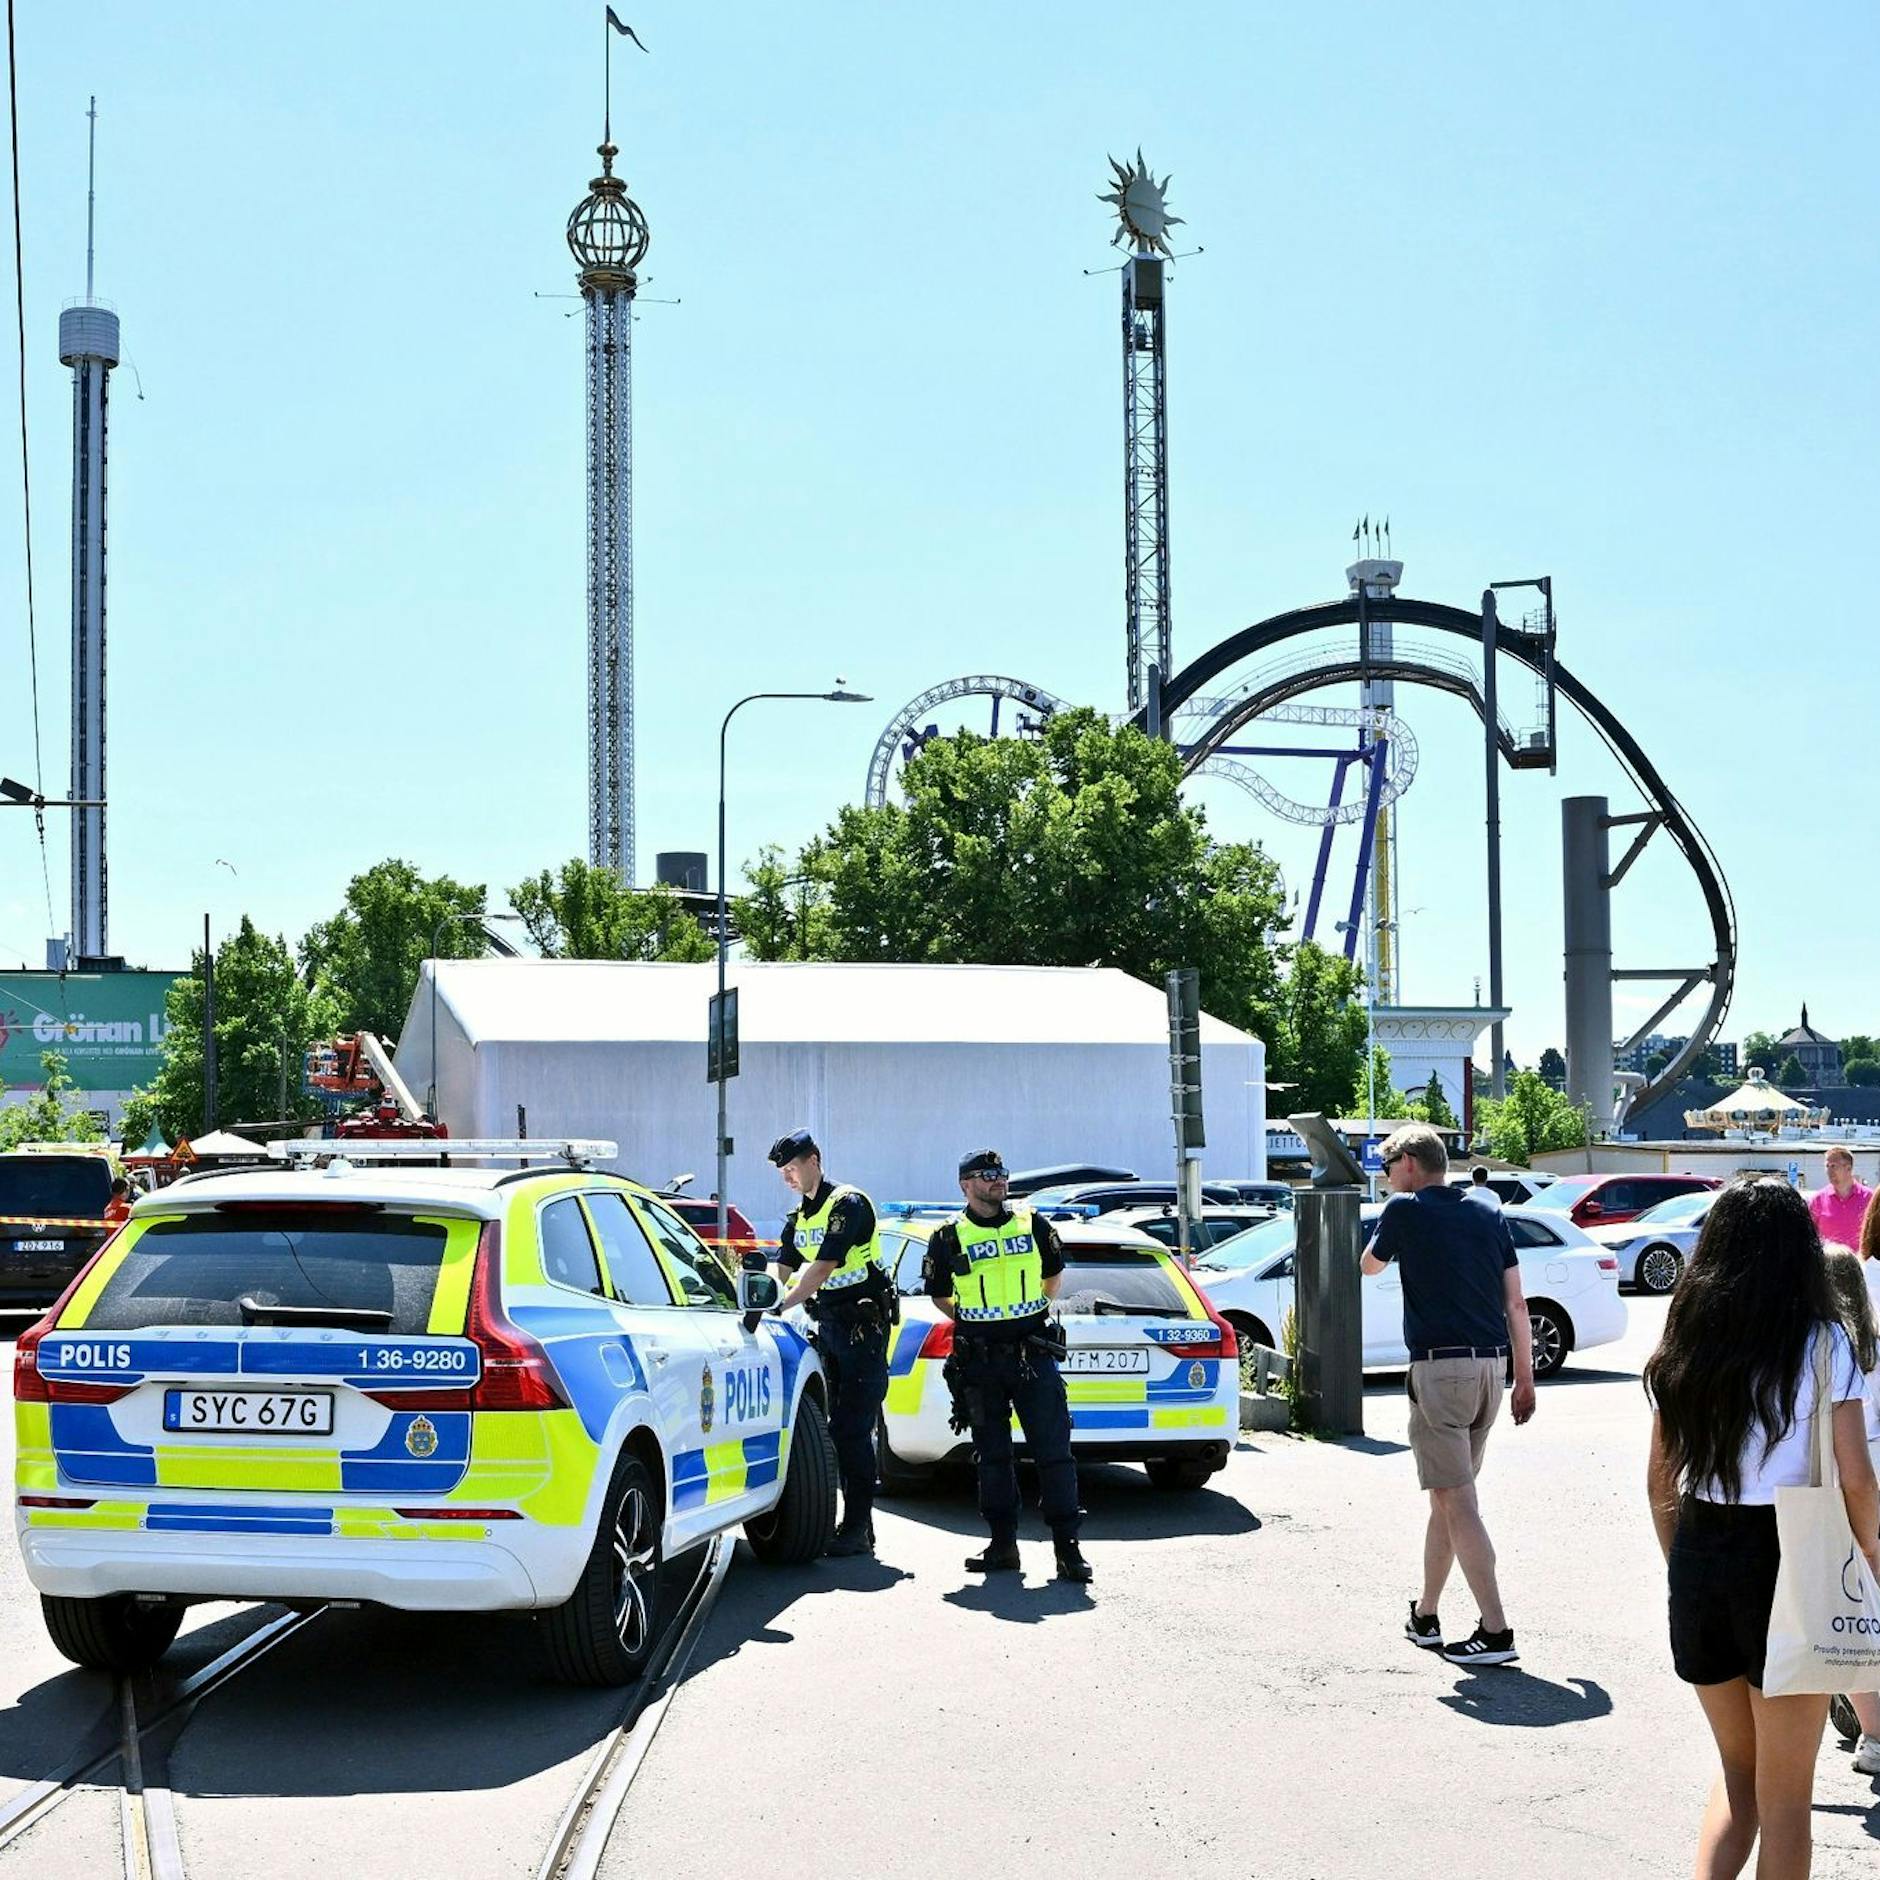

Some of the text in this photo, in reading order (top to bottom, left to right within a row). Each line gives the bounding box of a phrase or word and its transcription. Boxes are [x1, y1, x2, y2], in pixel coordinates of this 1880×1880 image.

[33, 1013, 143, 1043] Grönan
[1158, 1330, 1164, 1341] 1
[60, 1344, 131, 1368] POLIS
[358, 1350, 466, 1370] 1 36-9280
[1066, 1352, 1140, 1369] YFM 207
[725, 1365, 770, 1424] POLIS
[192, 1396, 248, 1425] SYC
[258, 1397, 317, 1426] 67G
